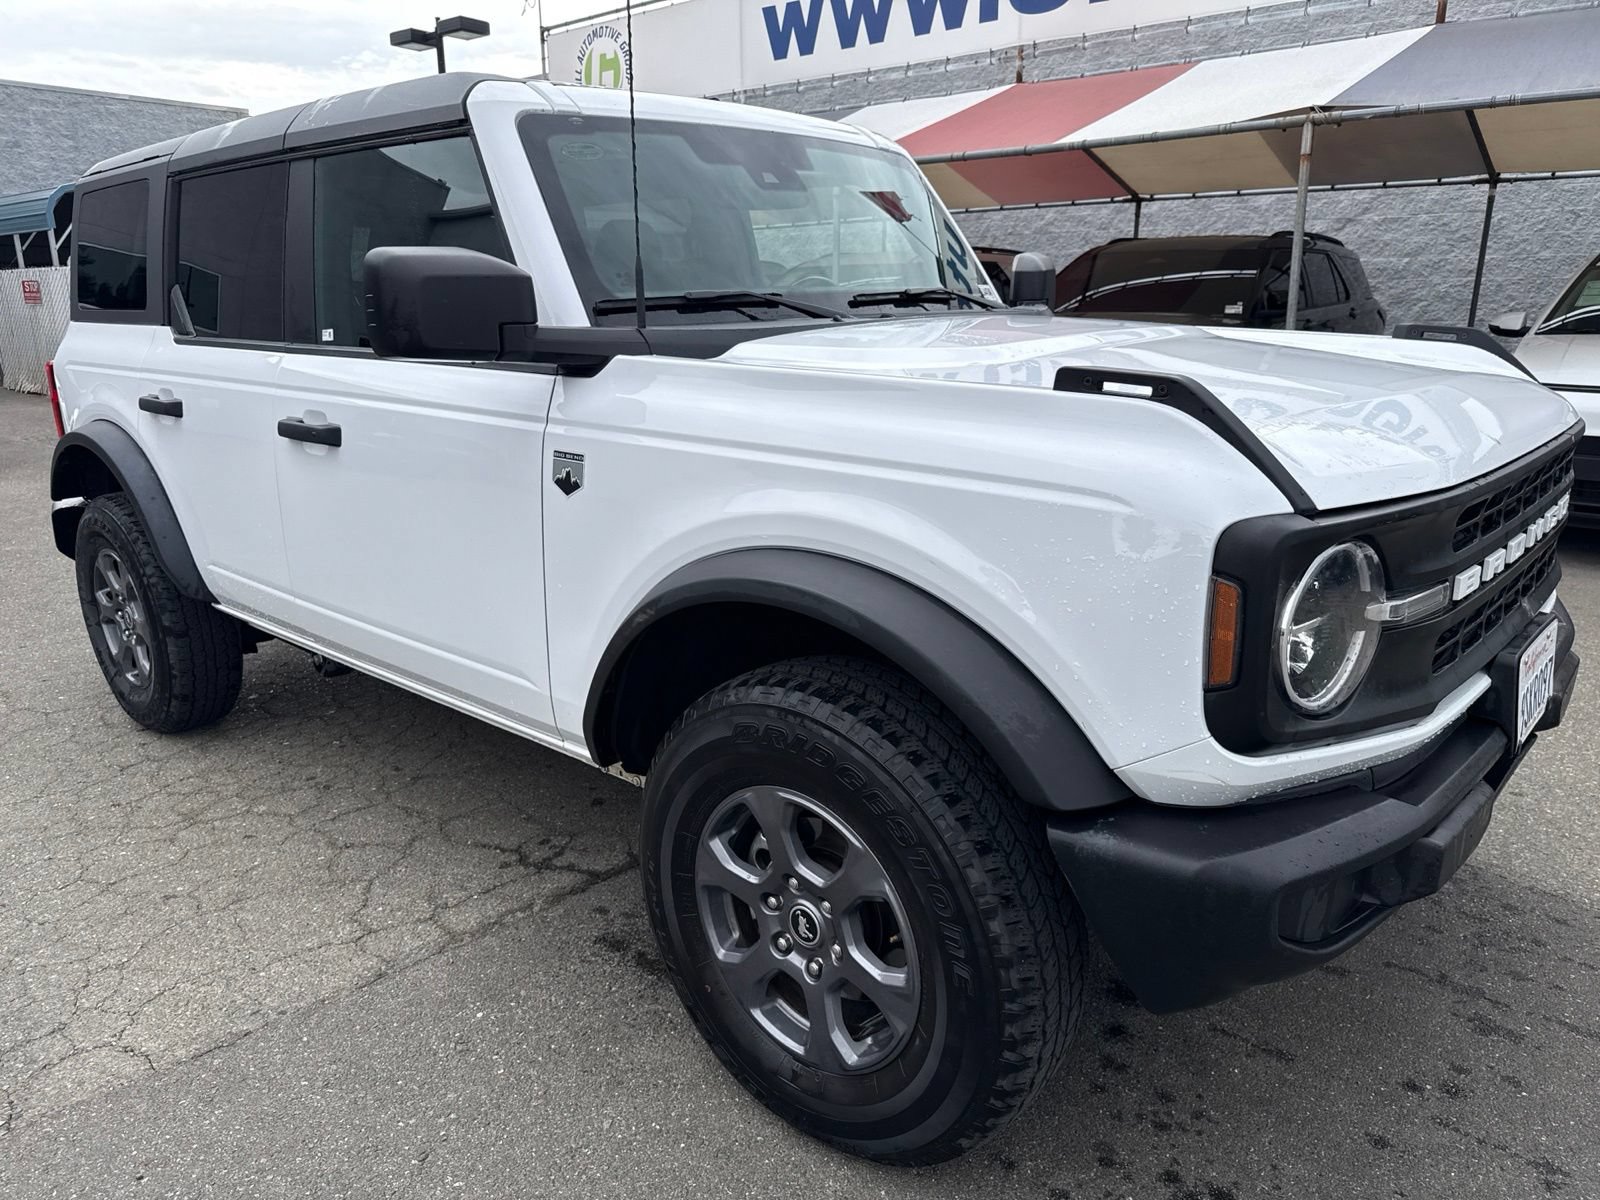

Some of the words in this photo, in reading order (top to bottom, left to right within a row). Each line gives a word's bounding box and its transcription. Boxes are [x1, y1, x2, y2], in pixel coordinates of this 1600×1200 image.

[577, 25, 622, 66] AUTOMOTIVE
[1452, 492, 1570, 601] BRONCO
[731, 721, 975, 997] BRIDGESTONE
